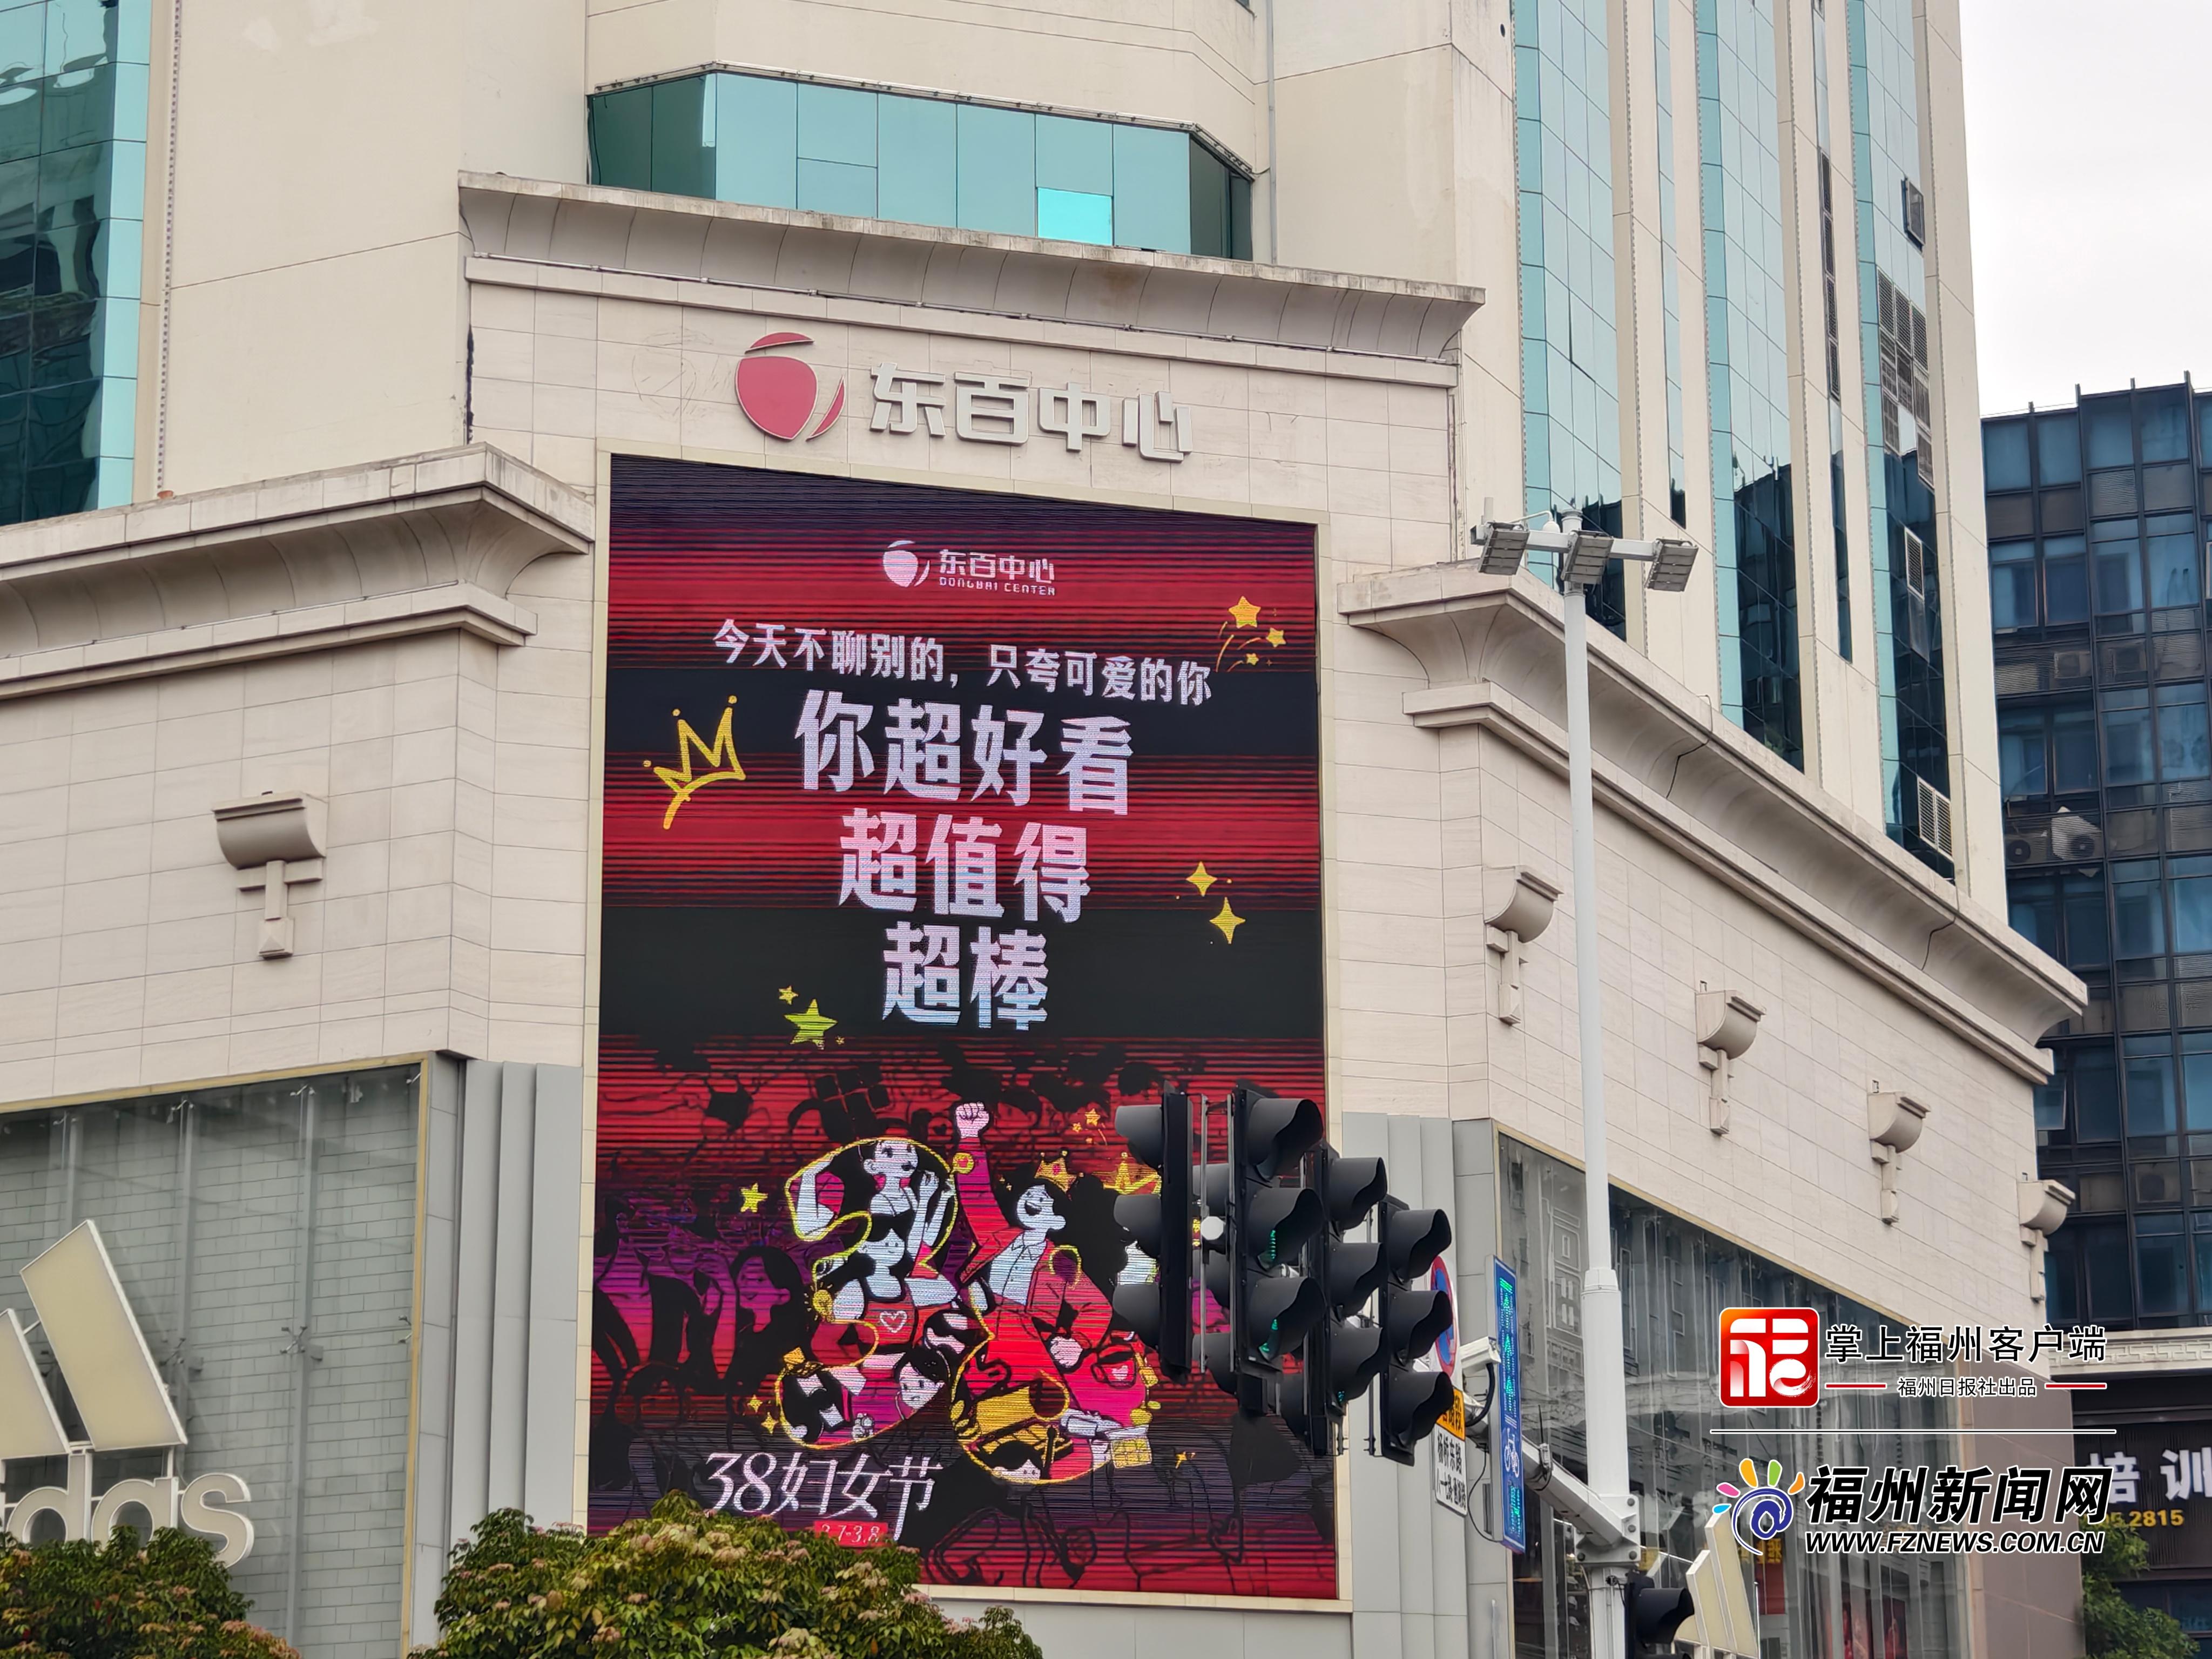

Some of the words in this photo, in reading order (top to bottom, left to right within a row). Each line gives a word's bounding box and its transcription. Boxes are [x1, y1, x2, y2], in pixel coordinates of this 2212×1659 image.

[871, 362, 1191, 463] 东百中心
[939, 549, 1055, 584] 东百中心
[939, 577, 998, 591] DONGBAI
[1004, 582, 1056, 596] CENTER
[794, 689, 1134, 815] 你超好看
[838, 808, 1091, 923] 超值得
[881, 921, 1049, 1031] 超棒
[0, 1453, 255, 1568] das
[705, 1452, 943, 1541] 38妇女节
